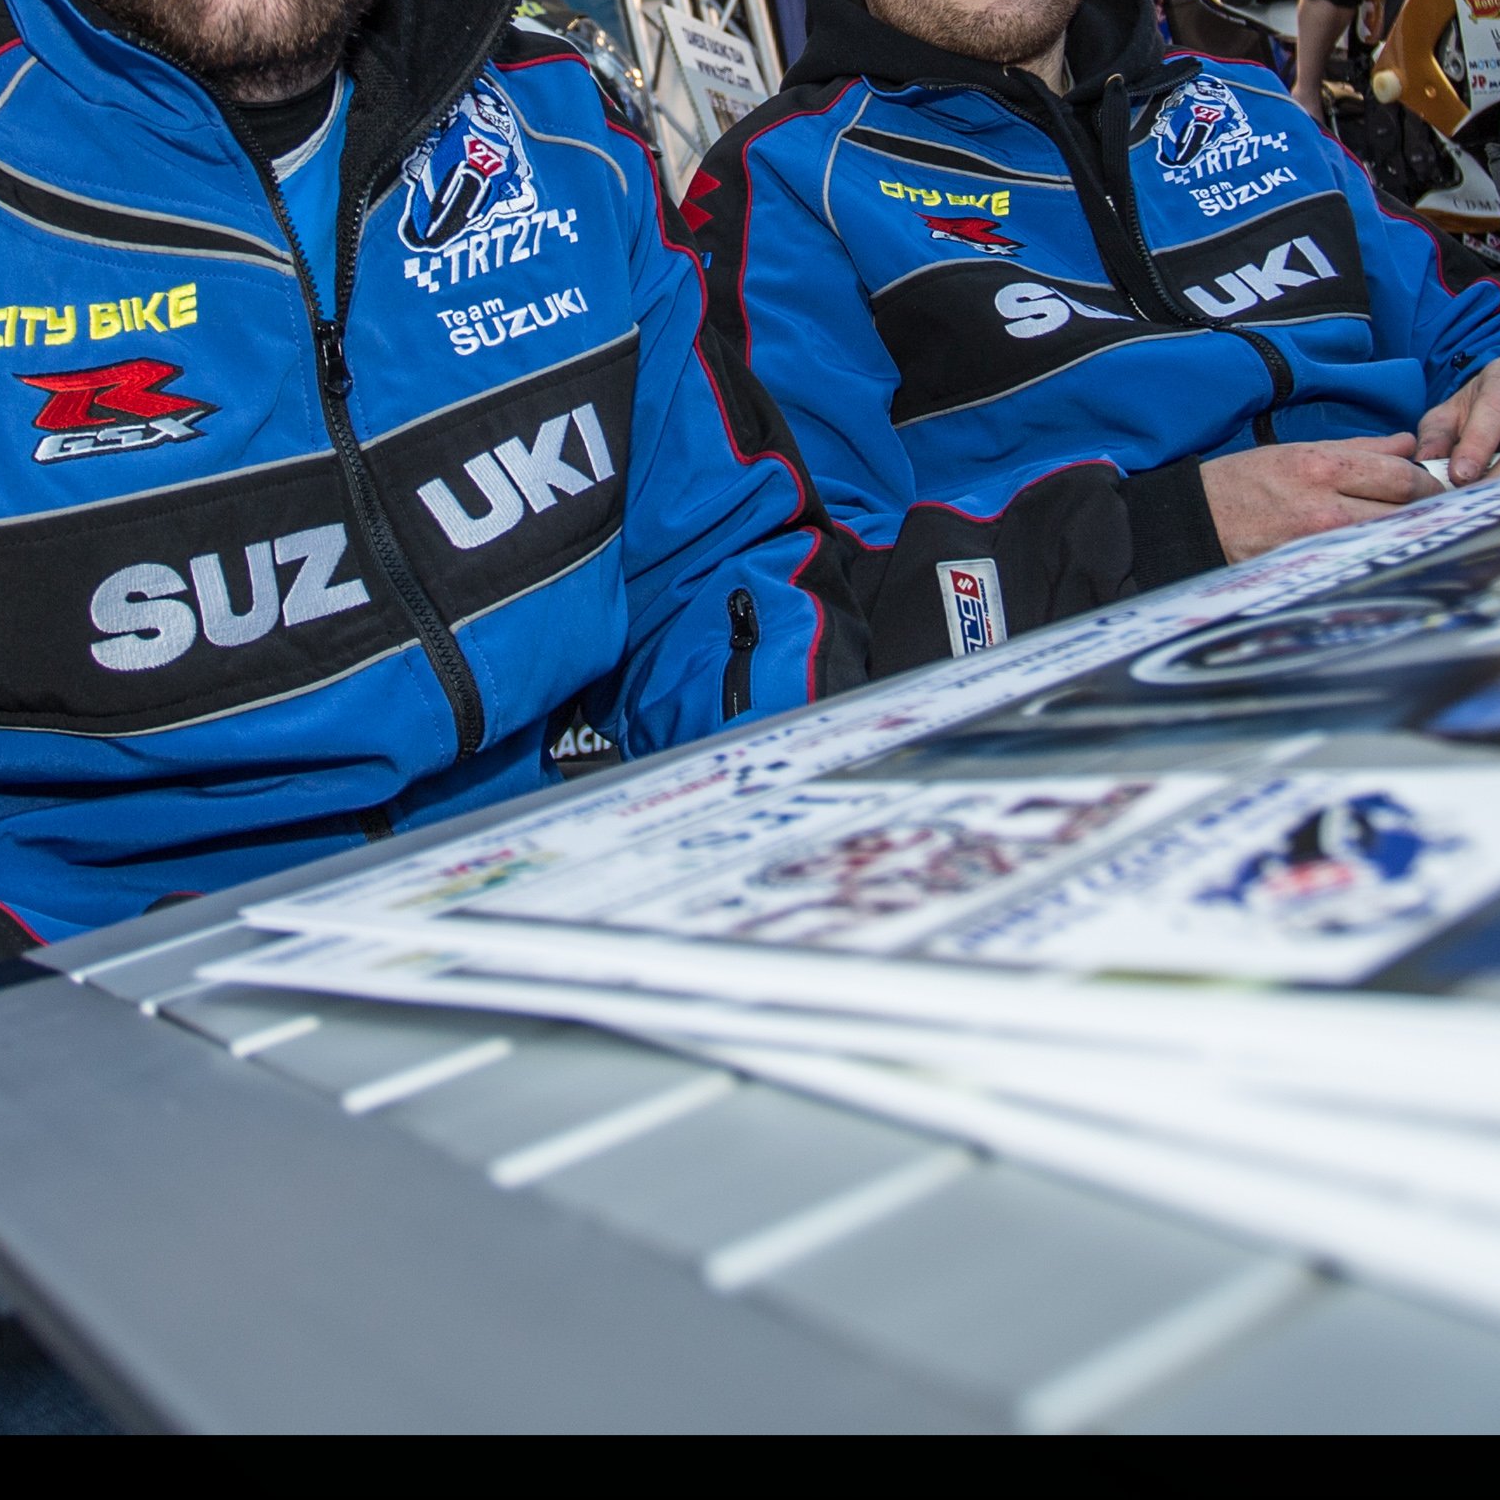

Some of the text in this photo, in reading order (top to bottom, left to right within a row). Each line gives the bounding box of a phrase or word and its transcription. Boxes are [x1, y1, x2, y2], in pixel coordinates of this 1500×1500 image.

[1199, 107, 1220, 121] 27
[467, 141, 498, 173] 27
[1189, 136, 1261, 179] TRT27
[1189, 181, 1234, 200] Team
[1198, 167, 1297, 217] SUZUKI
[442, 216, 547, 287] TRT27
[90, 282, 198, 342] BIKE
[438, 297, 506, 330] Team
[448, 286, 589, 357] SUZUKI
